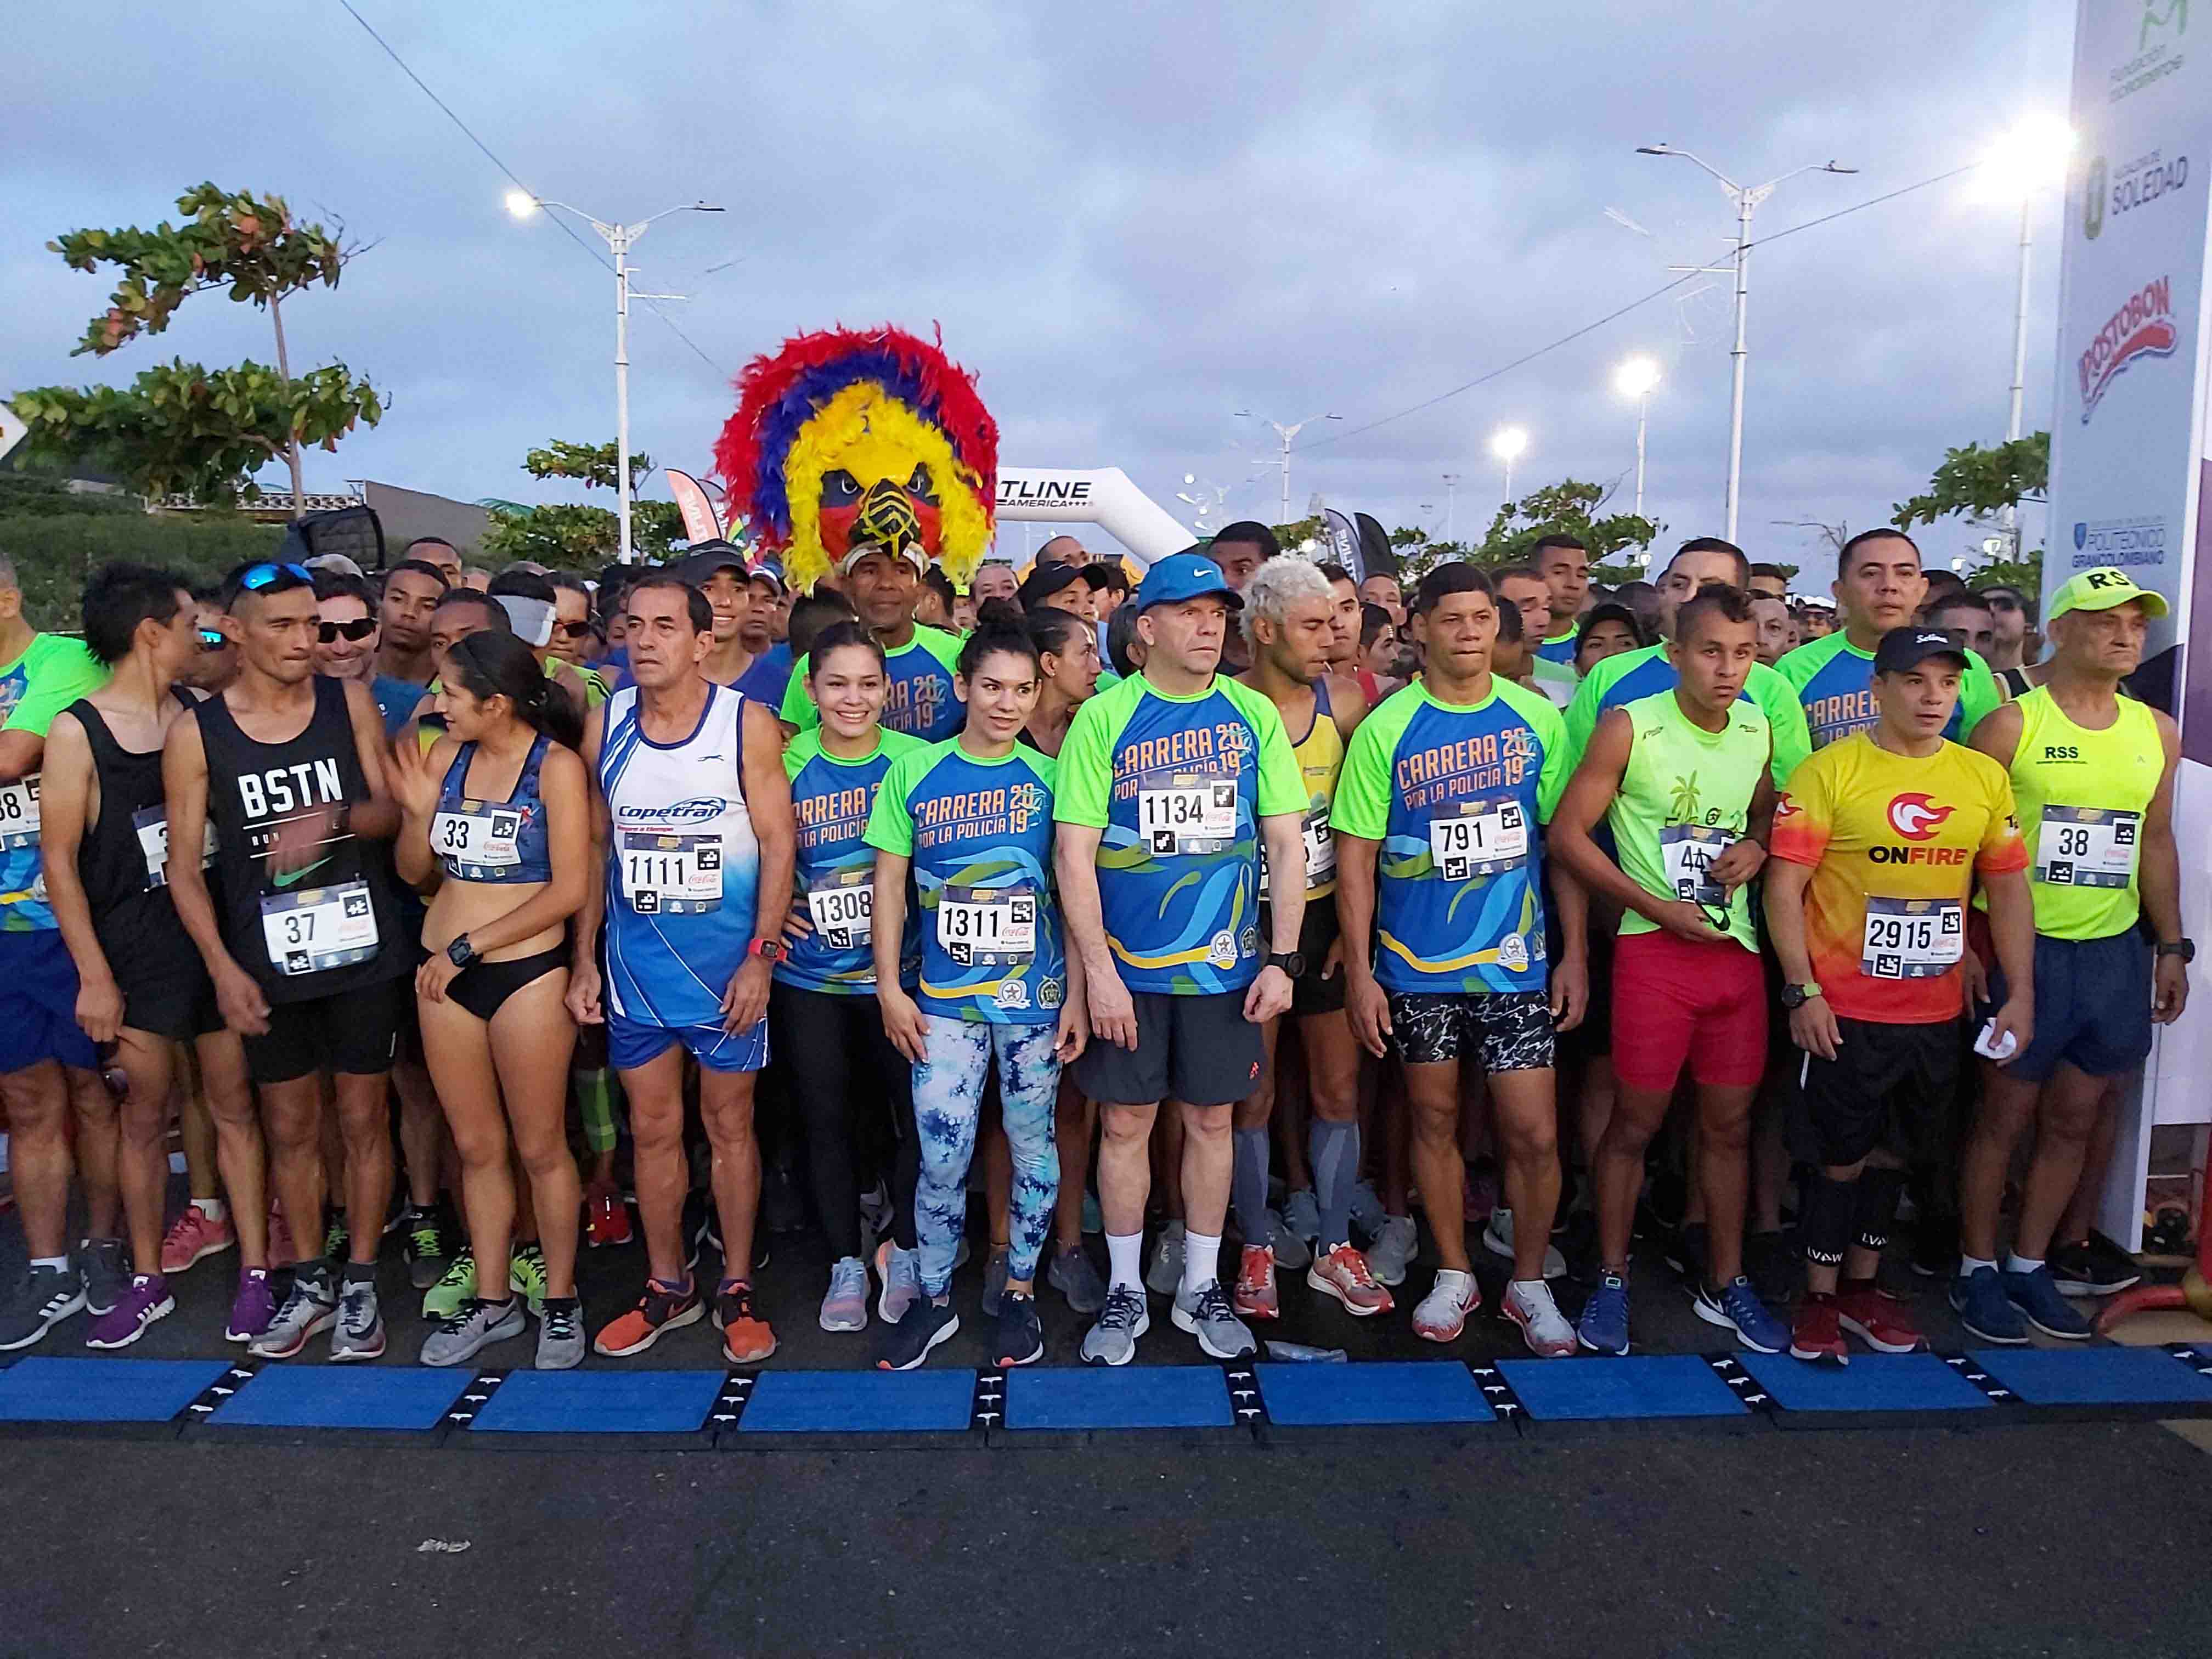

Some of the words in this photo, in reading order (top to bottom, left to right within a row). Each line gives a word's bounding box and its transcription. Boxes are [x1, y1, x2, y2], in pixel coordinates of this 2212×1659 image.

[2113, 156, 2188, 215] SOLEDAD
[914, 703, 933, 730] 19
[1397, 735, 1497, 790] CARRERA
[2045, 747, 2079, 759] RSS
[238, 758, 343, 819] BSTN
[1114, 779, 1137, 802] POR
[1430, 783, 1444, 803] LA
[1503, 756, 1523, 786] 19
[619, 806, 722, 819] Copetran
[915, 789, 1005, 827] CARRERA
[1146, 795, 1203, 824] 1134
[444, 820, 469, 849] 33
[805, 831, 816, 847] LA
[939, 826, 952, 844] LA
[1009, 809, 1028, 834] 19
[1439, 822, 1482, 851] 791
[1869, 846, 1967, 865] ONFIRE
[2058, 828, 2089, 856] 38
[630, 856, 683, 885] 1111
[1681, 845, 1705, 873] 44
[816, 890, 871, 923] 1308
[285, 913, 315, 944] 37
[945, 907, 997, 937] 1311
[1869, 919, 1931, 949] 2915
